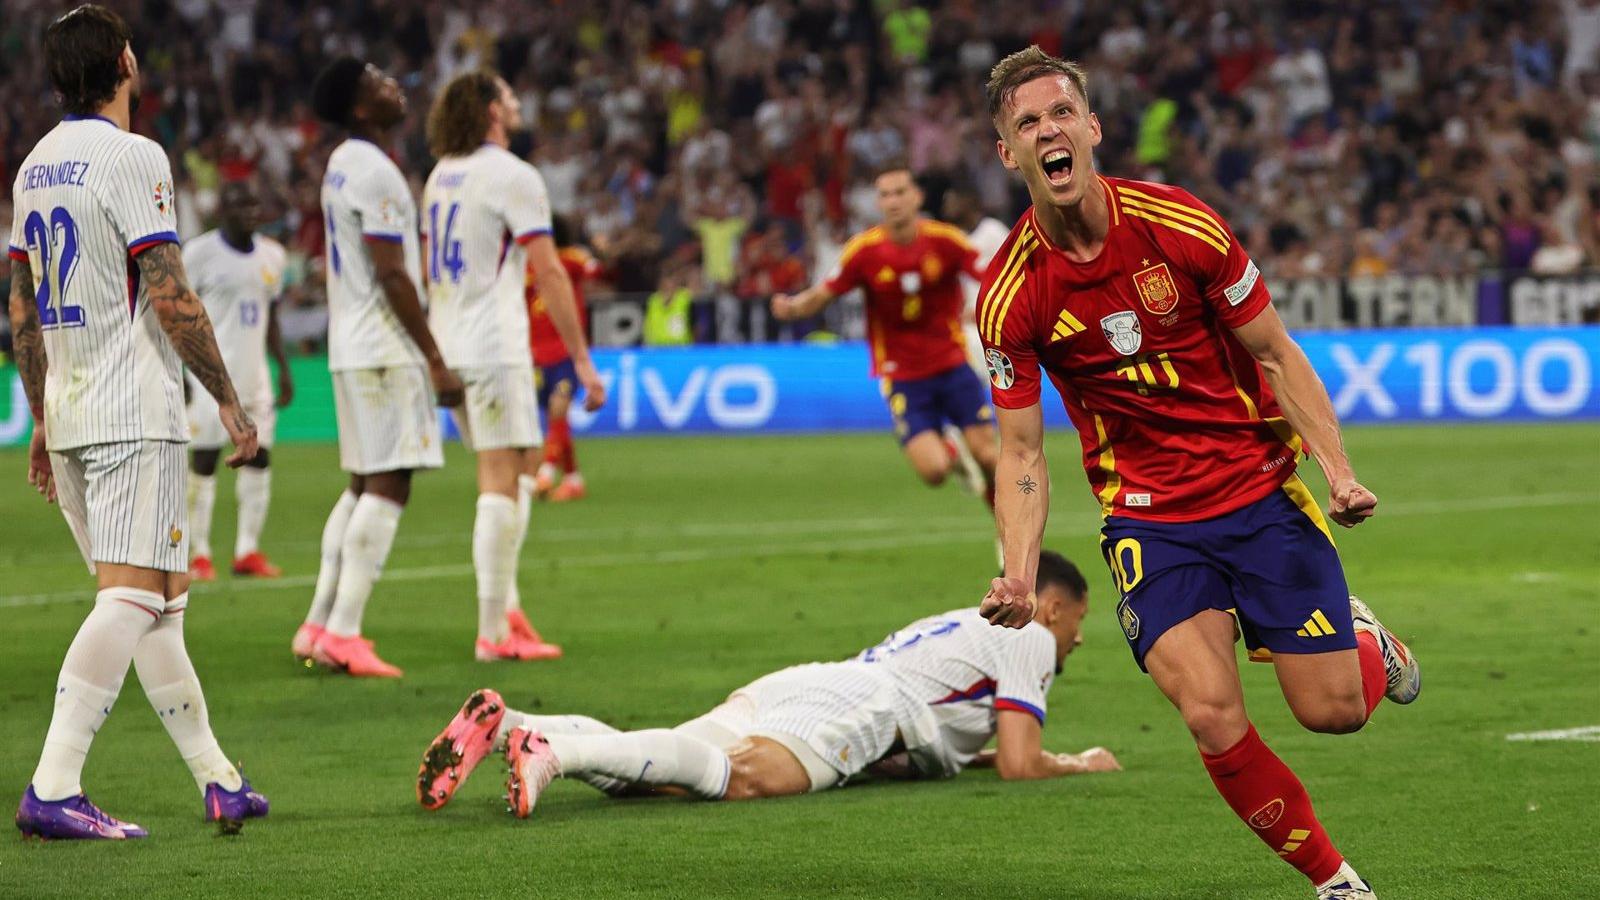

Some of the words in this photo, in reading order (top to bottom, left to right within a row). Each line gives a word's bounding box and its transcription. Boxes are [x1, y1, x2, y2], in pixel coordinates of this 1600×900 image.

[24, 206, 86, 329] 22
[429, 202, 466, 282] 14
[1116, 352, 1180, 396] 10
[1332, 337, 1592, 417] X100
[1108, 537, 1144, 596] 10
